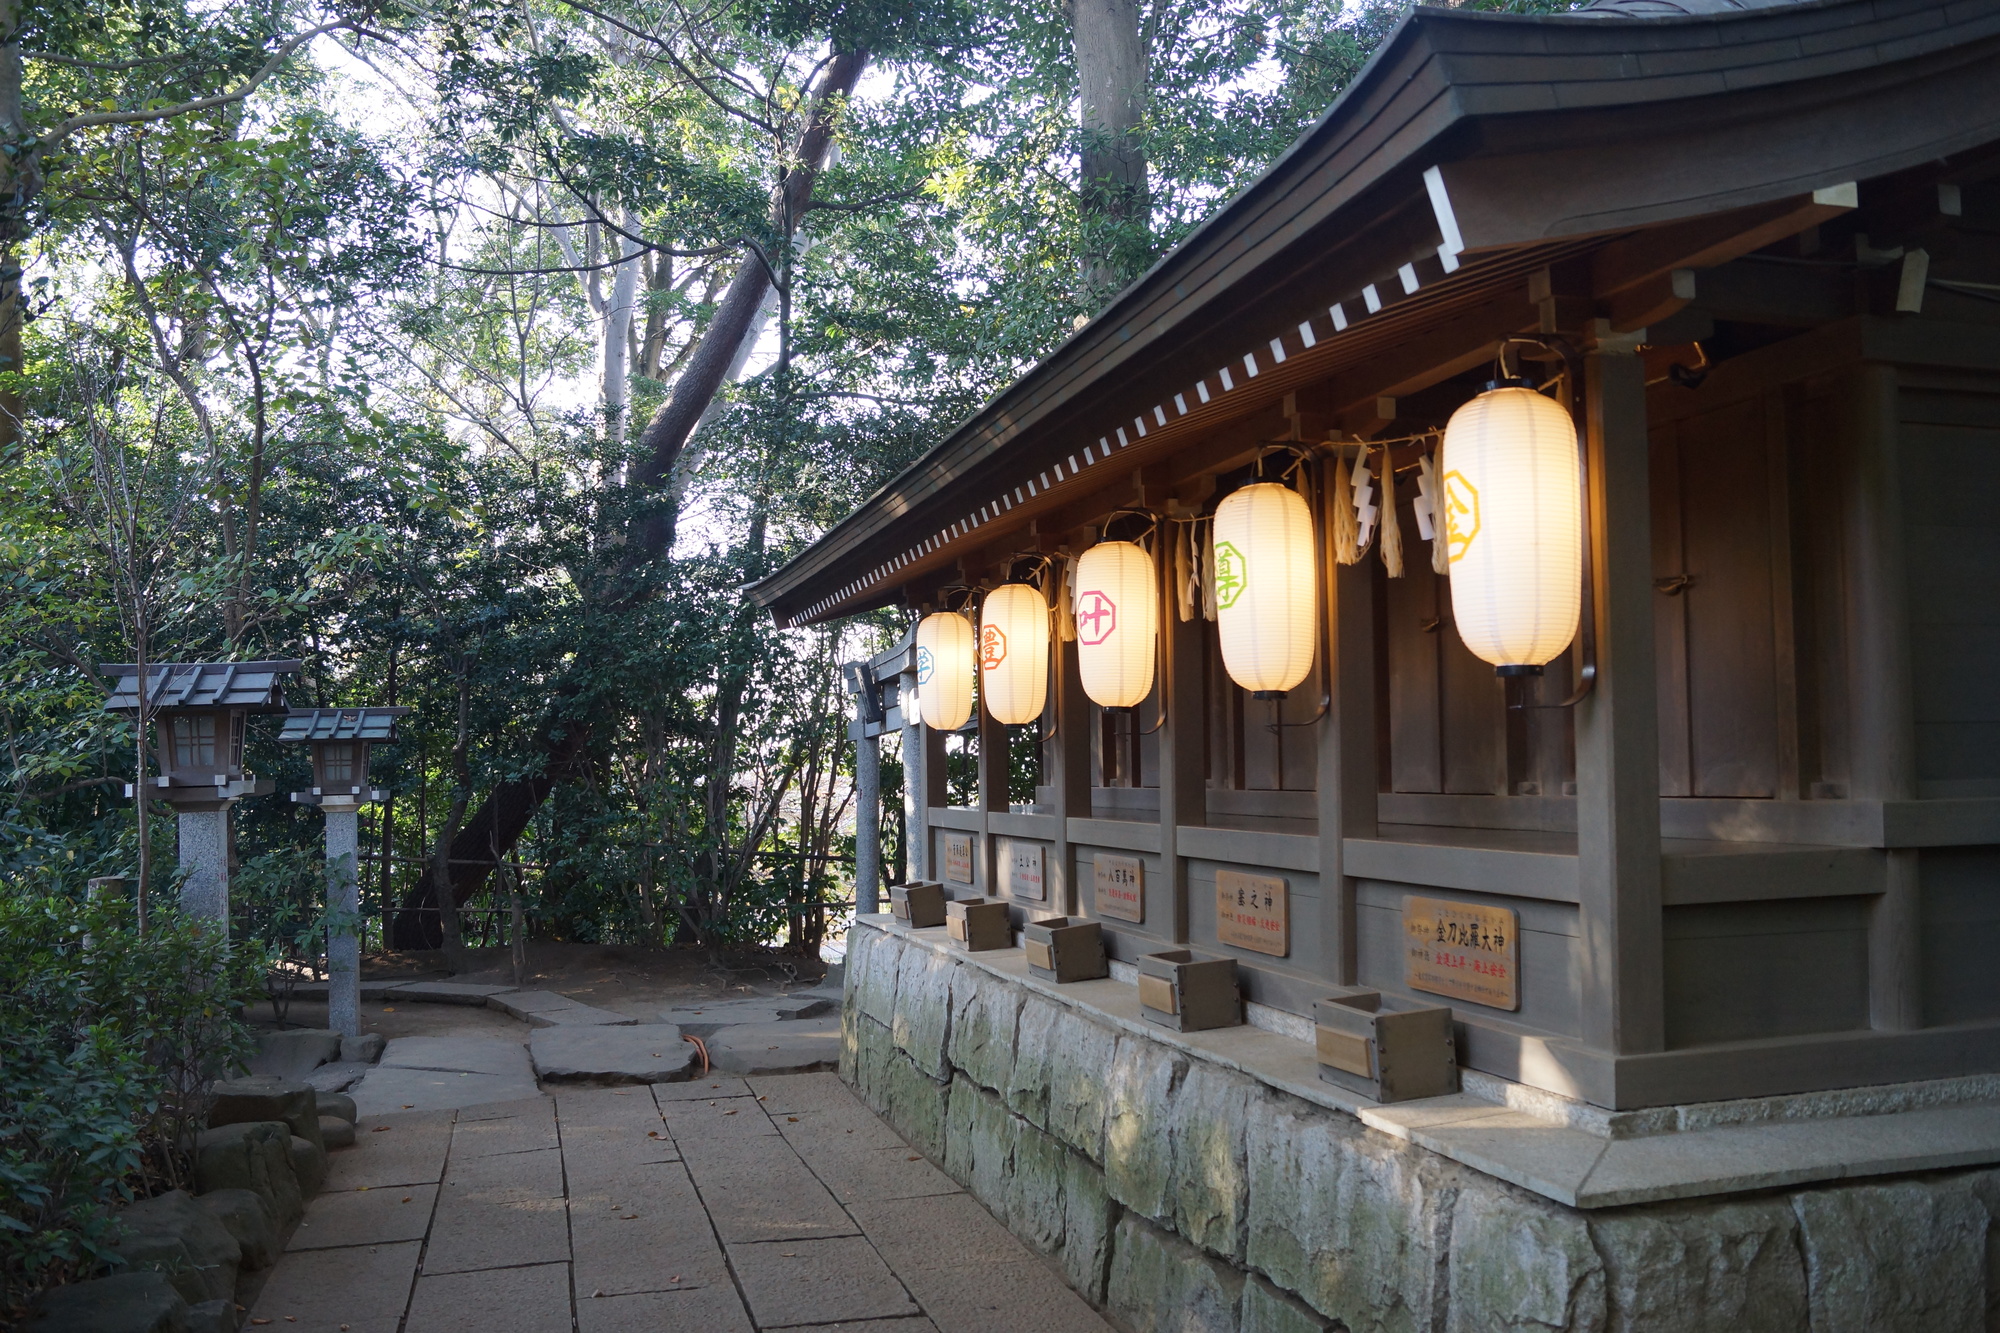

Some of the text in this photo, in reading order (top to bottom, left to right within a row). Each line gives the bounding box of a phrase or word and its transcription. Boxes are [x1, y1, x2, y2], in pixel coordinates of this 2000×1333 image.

[1079, 596, 1111, 637] 叶
[1108, 868, 1136, 888] 八百萬神
[1437, 918, 1505, 955] 金刀比羅大神
